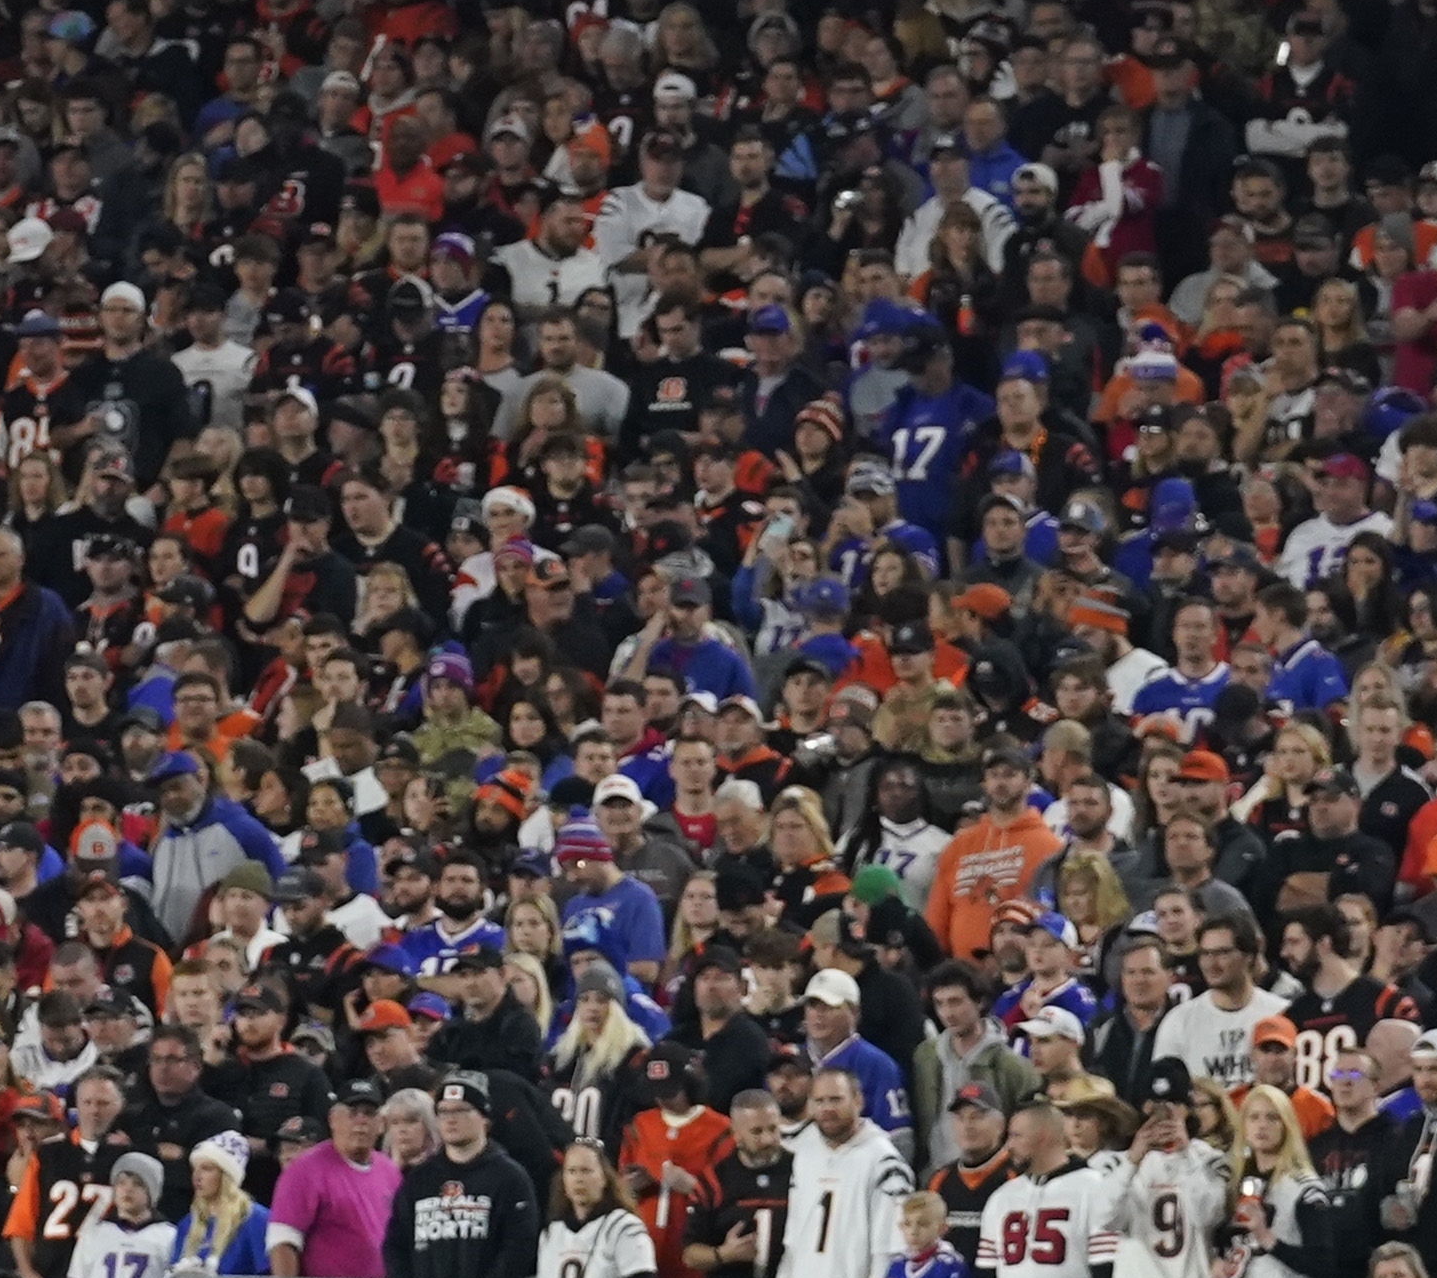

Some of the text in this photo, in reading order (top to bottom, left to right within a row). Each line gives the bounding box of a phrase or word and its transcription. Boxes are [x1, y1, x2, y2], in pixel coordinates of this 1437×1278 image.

[892, 427, 944, 481] 17
[43, 1181, 112, 1237] 27
[415, 1220, 489, 1240] NORTH
[814, 1192, 833, 1252] 1
[1151, 1194, 1183, 1258] 9
[1004, 1212, 1069, 1265] 85
